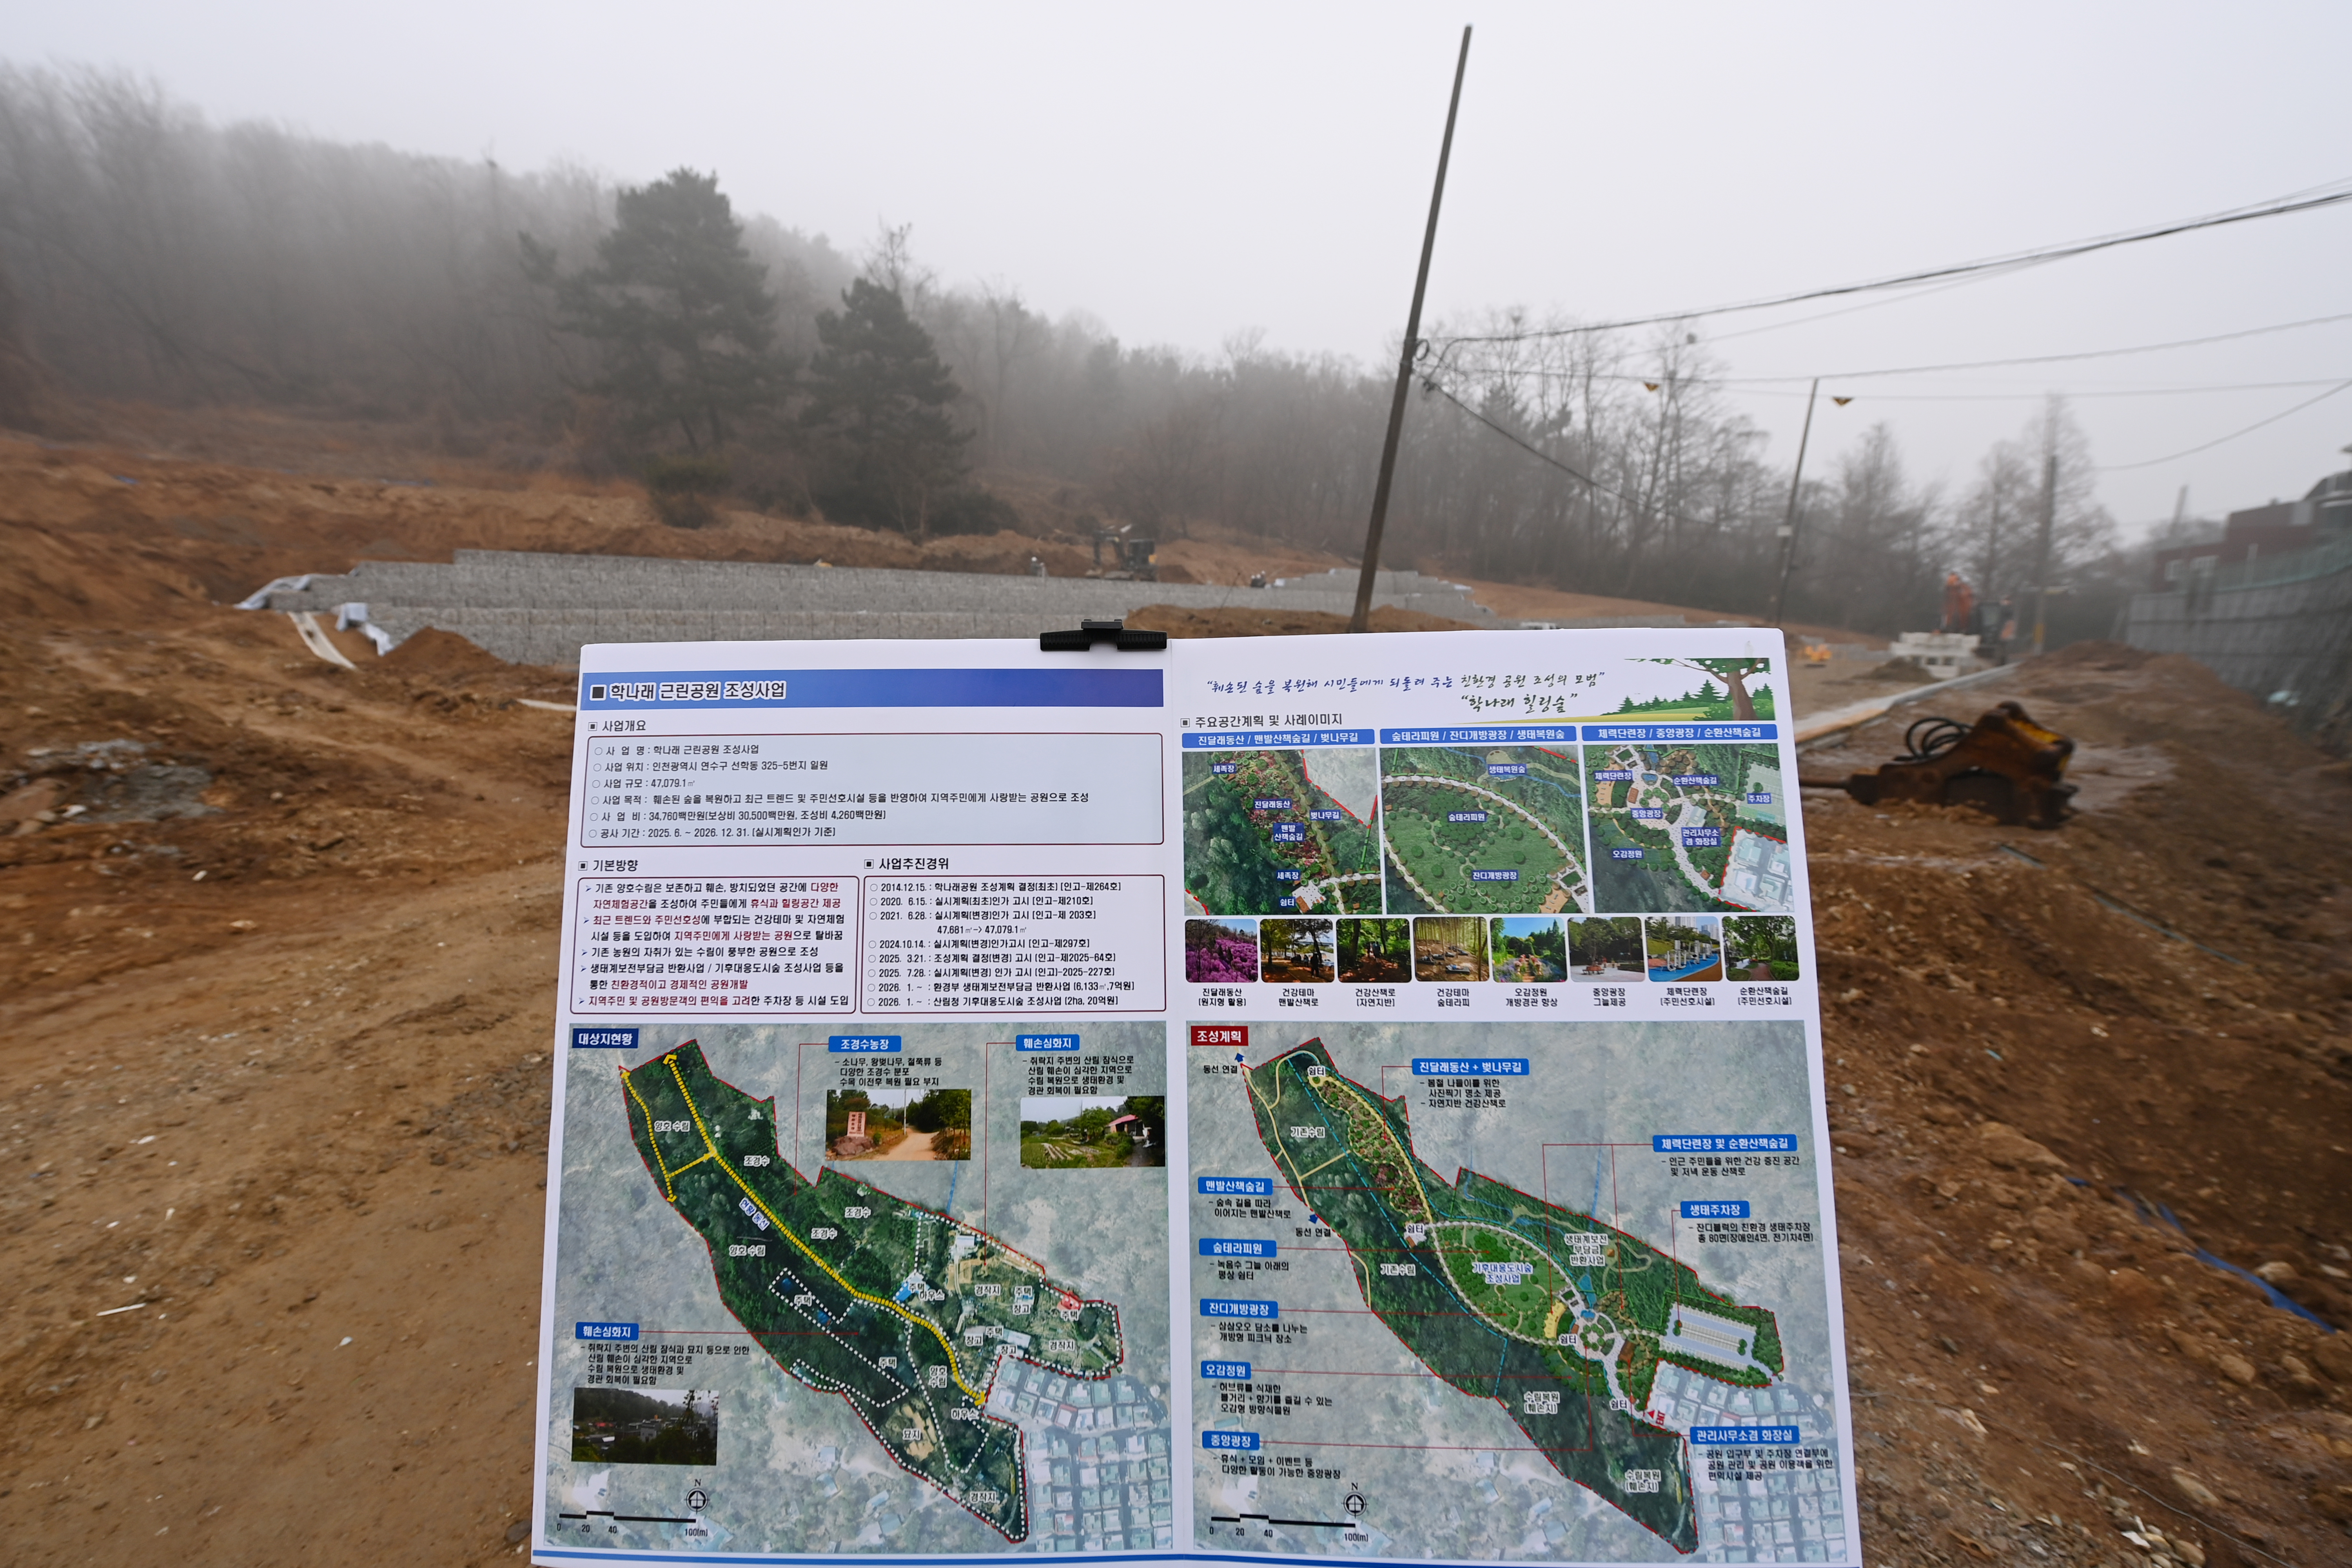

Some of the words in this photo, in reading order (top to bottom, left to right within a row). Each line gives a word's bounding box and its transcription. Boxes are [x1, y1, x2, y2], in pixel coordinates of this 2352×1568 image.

[1252, 680, 1275, 695] 숲을
[1282, 679, 1318, 690] 복원해
[1324, 678, 1383, 692] 시민들에게
[1390, 677, 1425, 691] 되돌려
[1431, 677, 1452, 688] 주는
[1461, 674, 1495, 688] 친환경
[1503, 675, 1526, 688] 공원
[1534, 673, 1567, 687] 조성의
[611, 684, 654, 699] 학나래
[661, 684, 719, 698] 근린공원
[725, 682, 784, 698] 조성사업
[1196, 715, 1263, 728] 주요공간계획
[1269, 715, 1279, 726] 및
[1285, 713, 1342, 726] 사례이미지
[602, 720, 646, 732] 사업개요
[1392, 731, 1439, 741] 숲테라피원
[1450, 731, 1507, 740] 잔디개방광장
[1517, 730, 1564, 740] 생태복원숲
[1599, 729, 1646, 739] 체력단련장
[1657, 728, 1694, 738] 중앙광장
[1704, 728, 1760, 737] 순환산책숲길
[1199, 735, 1244, 746] 진달래동산
[1255, 734, 1310, 744] 맨발산책숲길
[1321, 733, 1358, 742] 벚나무길
[653, 746, 680, 755] 학나래
[684, 745, 719, 754] 근린공원
[723, 745, 759, 754] 조성사업
[605, 763, 622, 772] 사업
[626, 762, 643, 771] 위치
[653, 762, 697, 771] 인천광역시
[701, 762, 727, 771] 연수구
[731, 762, 758, 771] 선학동
[761, 761, 806, 770] 325-5번지
[811, 761, 828, 770] 일원
[1489, 765, 1525, 774] 생태복원숲
[1595, 771, 1632, 780] 체력단련장
[604, 779, 621, 788] 사업
[625, 779, 642, 788] 규모
[1674, 777, 1717, 785] 순환산책숲길
[603, 795, 620, 804] 사업
[624, 795, 641, 804] 목적
[653, 795, 680, 804] 훼손된
[684, 795, 701, 804] 숲을
[706, 794, 741, 804] 복원하고
[745, 794, 762, 803] 최근
[767, 794, 793, 803] 트렌드
[798, 794, 806, 803] 및
[810, 793, 864, 803] 주민선호시설
[868, 793, 882, 803] 등을
[891, 793, 927, 803] 반영하여
[931, 793, 986, 802] 지역주민에게
[990, 793, 1026, 802] 사랑받는
[1031, 793, 1067, 802] 공원으로
[1071, 793, 1089, 802] 조성
[1748, 793, 1769, 802] 주차장
[800, 810, 827, 820] 조성비
[1311, 811, 1339, 819] 벚나무길
[1449, 813, 1485, 821] 숲테라피원
[1632, 809, 1661, 818] 중앙광장
[1274, 833, 1303, 841] 산책숲길
[1613, 850, 1642, 858] 오감정원
[593, 860, 638, 871] 기본방향
[879, 858, 948, 870] 사업추진경위
[1473, 871, 1517, 880] 잔디개방광장
[595, 884, 613, 893] 기존
[617, 883, 662, 893] 양호수림은
[666, 883, 701, 893] 보존하고
[706, 883, 726, 893] 훼손,
[730, 883, 775, 893] 방치되었던
[779, 883, 807, 892] 공간에
[811, 883, 838, 892] 다양한
[935, 882, 977, 892] 학나래공원
[981, 882, 1014, 892] 조성계획
[1203, 988, 1242, 997] 진달래동산
[1283, 989, 1314, 997] 건강테마
[1356, 989, 1395, 997] 건강산책로
[1515, 988, 1547, 996] 오감정원
[1667, 987, 1707, 996] 체력단련장
[1279, 998, 1318, 1007] 맨발산책로
[1594, 998, 1626, 1007] 그늘제공
[579, 1033, 632, 1045] 대상지현황
[1198, 1031, 1241, 1042] 조성계획
[841, 1039, 889, 1049] 조경수농장
[1024, 1038, 1071, 1049] 훼손심화지
[842, 1058, 868, 1066] 소나무,
[935, 1058, 942, 1066] 등
[840, 1068, 864, 1076] 다양한
[867, 1068, 891, 1076] 조경수
[895, 1068, 909, 1076] 분포
[1028, 1067, 1043, 1075] 산림
[1047, 1066, 1070, 1074] 훼손이
[1074, 1066, 1097, 1074] 심각한
[1101, 1065, 1132, 1074] 지역으로
[1420, 1062, 1469, 1073] 진달래동산
[1482, 1062, 1521, 1073] 벚나무길
[1429, 1099, 1461, 1107] 자연지반
[1465, 1099, 1506, 1108] 건강산책로
[1662, 1139, 1711, 1149] 체력단련장
[1716, 1139, 1724, 1149] 및
[1729, 1138, 1788, 1149] 순환산책숲길
[1670, 1157, 1685, 1166] 인근
[1725, 1157, 1741, 1165] 위한
[1745, 1157, 1760, 1165] 건강
[1784, 1156, 1799, 1165] 공간
[1206, 1181, 1264, 1192] 맨발산책숲길
[1690, 1205, 1740, 1216] 생태주차장
[812, 1229, 836, 1238] 조경수
[1214, 1243, 1262, 1254] 숲테라피원
[1571, 1256, 1604, 1265] 반환사업
[1486, 1274, 1519, 1283] 조성사업
[976, 1285, 1000, 1294] 경작지
[1013, 1305, 1030, 1314] 창고
[1210, 1303, 1269, 1315] 잔디개방광장
[583, 1326, 630, 1338] 훼손심화지
[1207, 1365, 1245, 1377] 오감정원
[904, 1430, 920, 1439] 묘지
[1697, 1430, 1758, 1441] 관리사무소겸
[1762, 1430, 1792, 1441] 화장실
[1211, 1435, 1250, 1447] 중앙광장
[581, 1524, 590, 1533] 20
